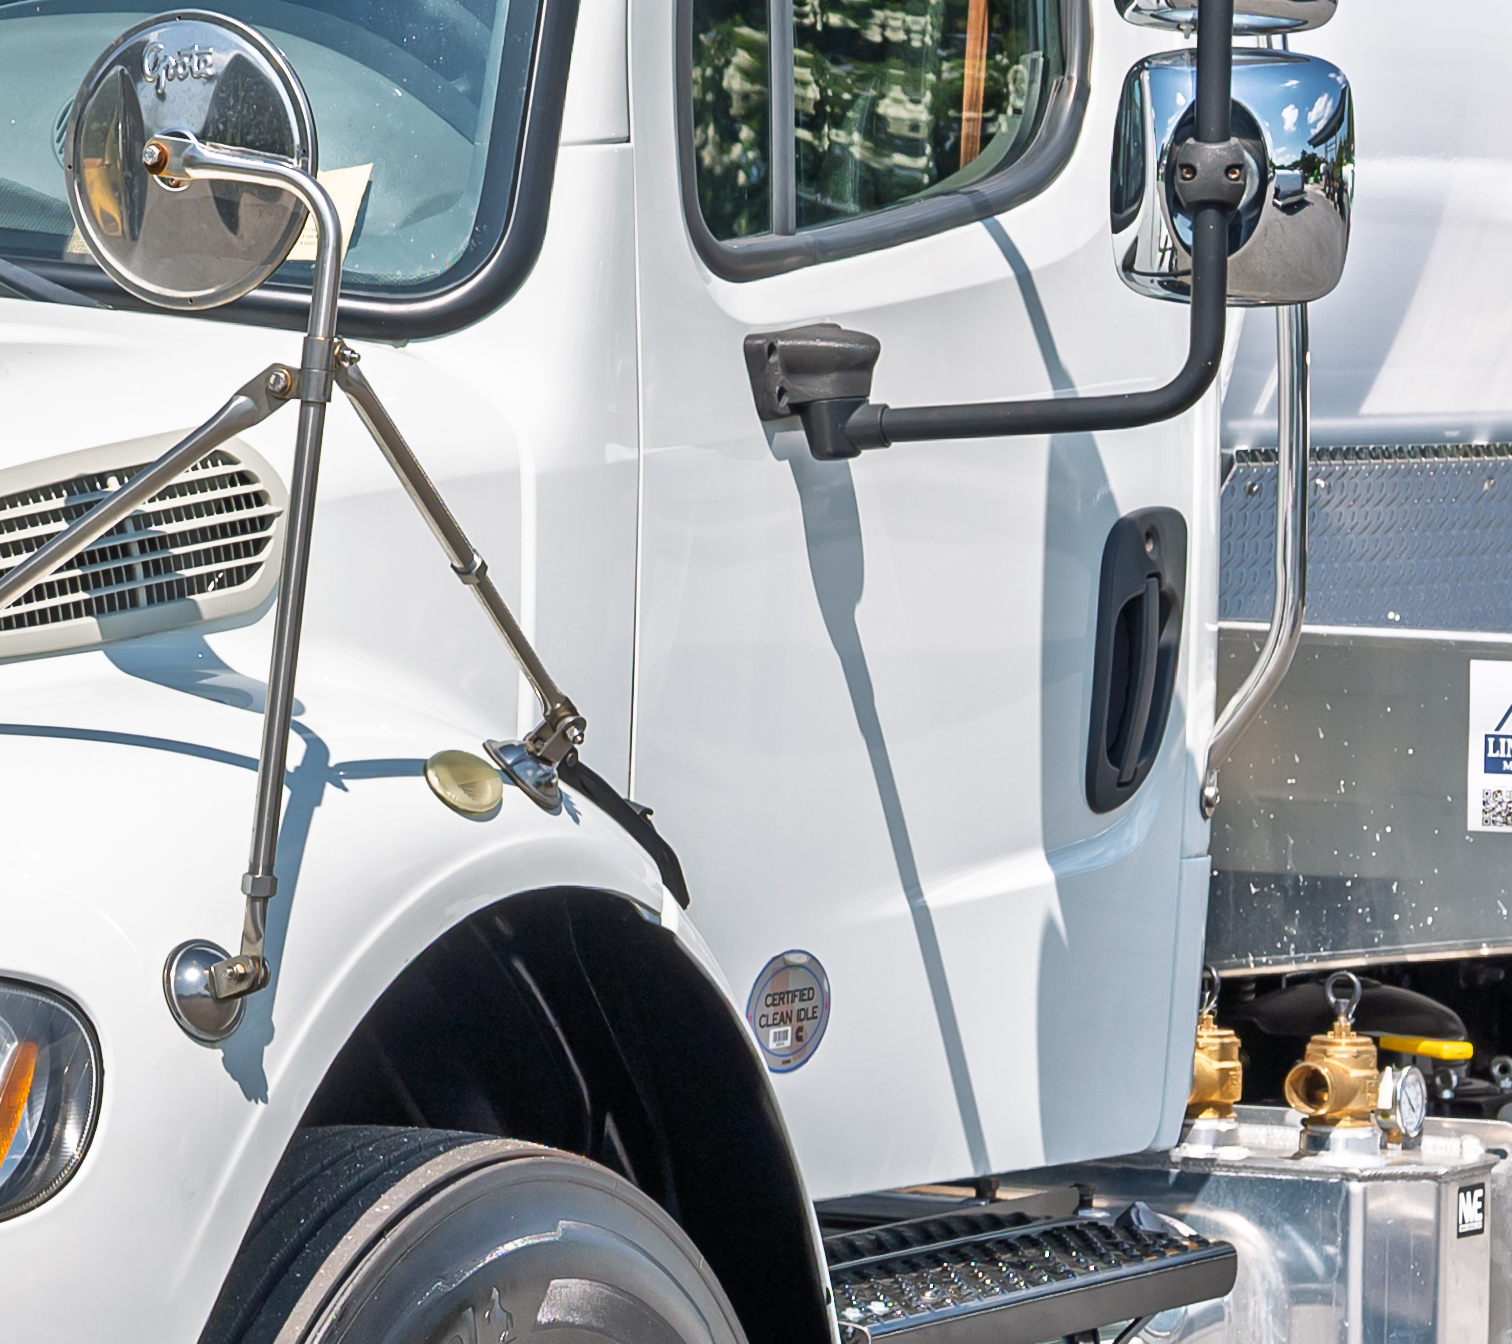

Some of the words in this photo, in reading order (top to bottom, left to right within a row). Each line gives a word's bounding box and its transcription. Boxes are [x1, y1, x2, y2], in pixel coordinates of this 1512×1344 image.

[141, 42, 215, 95] Grote
[764, 986, 815, 1008] CERTIFIED
[758, 1009, 793, 1029] CLEAN
[796, 1005, 819, 1022] IDLE
